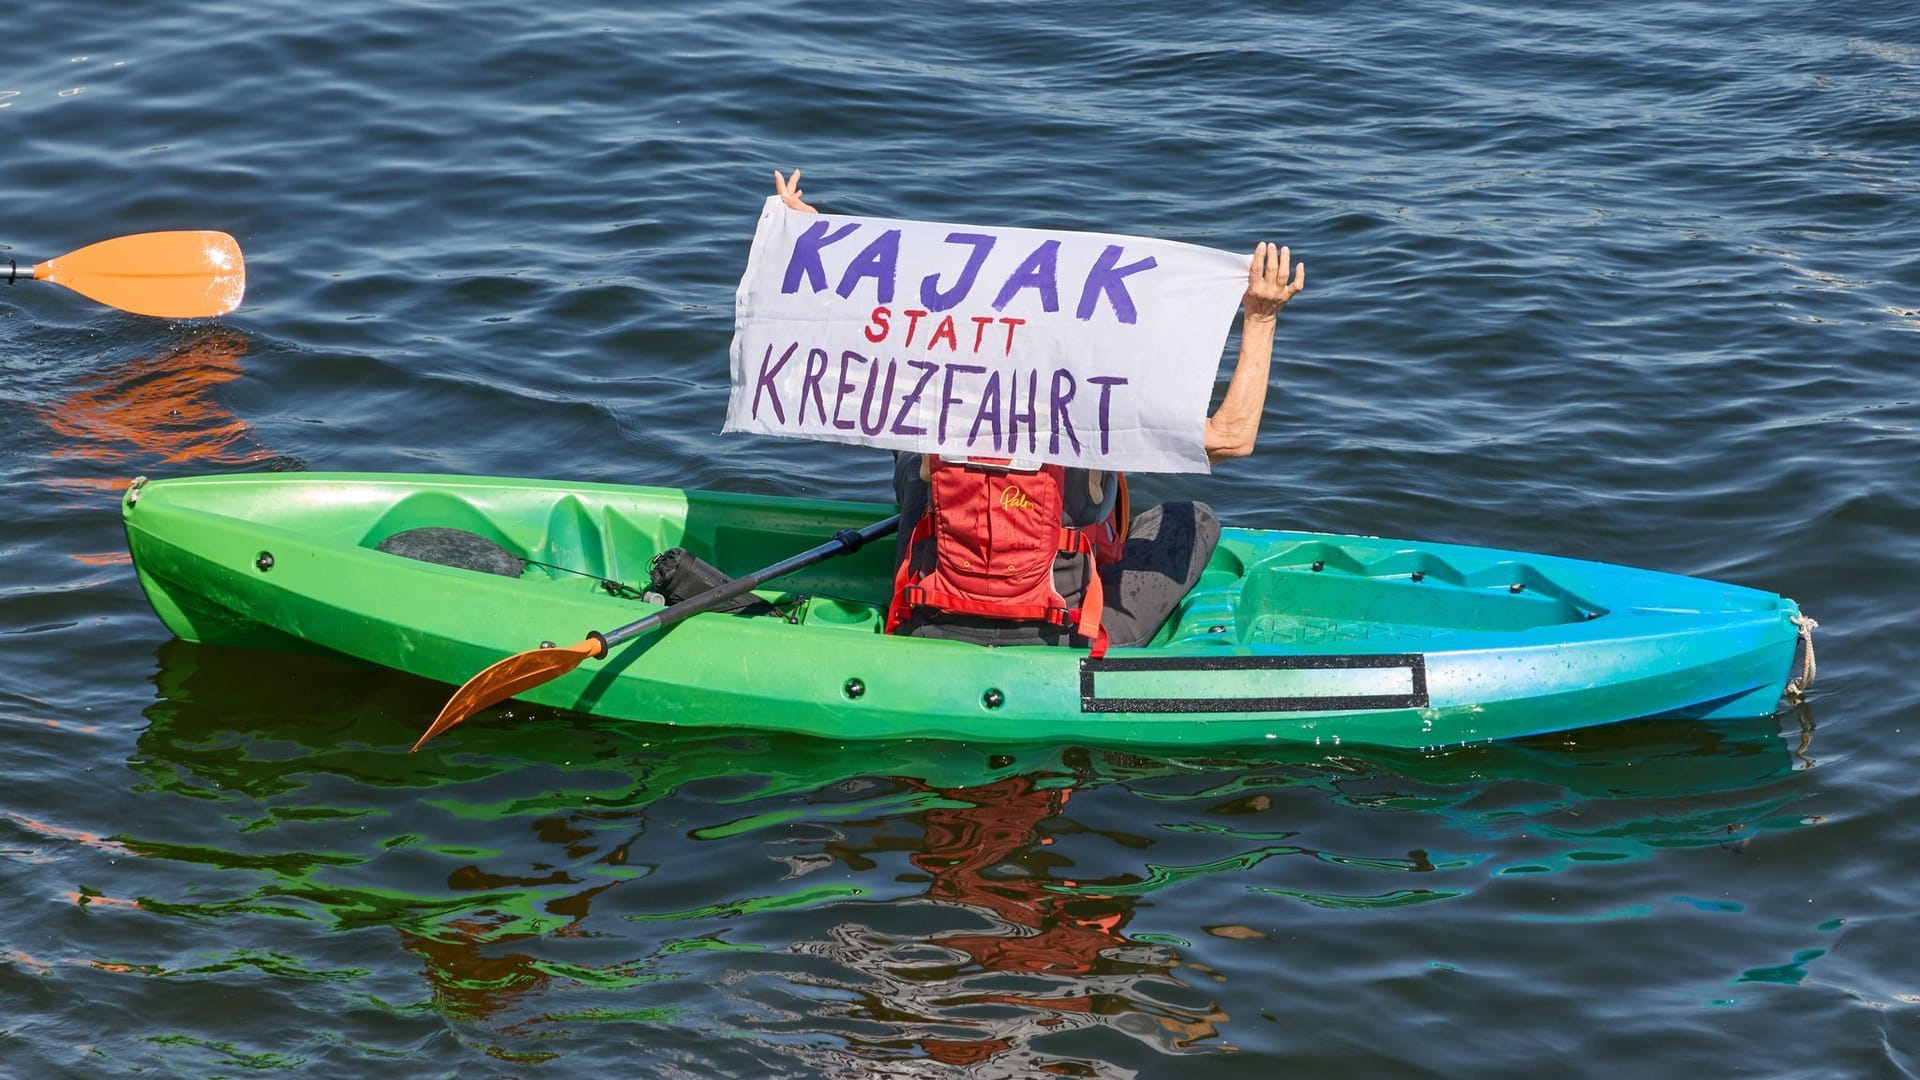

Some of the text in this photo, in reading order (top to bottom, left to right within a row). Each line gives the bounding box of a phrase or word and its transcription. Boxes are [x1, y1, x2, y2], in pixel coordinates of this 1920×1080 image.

[781, 220, 1158, 324] KAJAK
[864, 306, 1026, 356] STATT
[752, 342, 1128, 457] KREUZFAHRT
